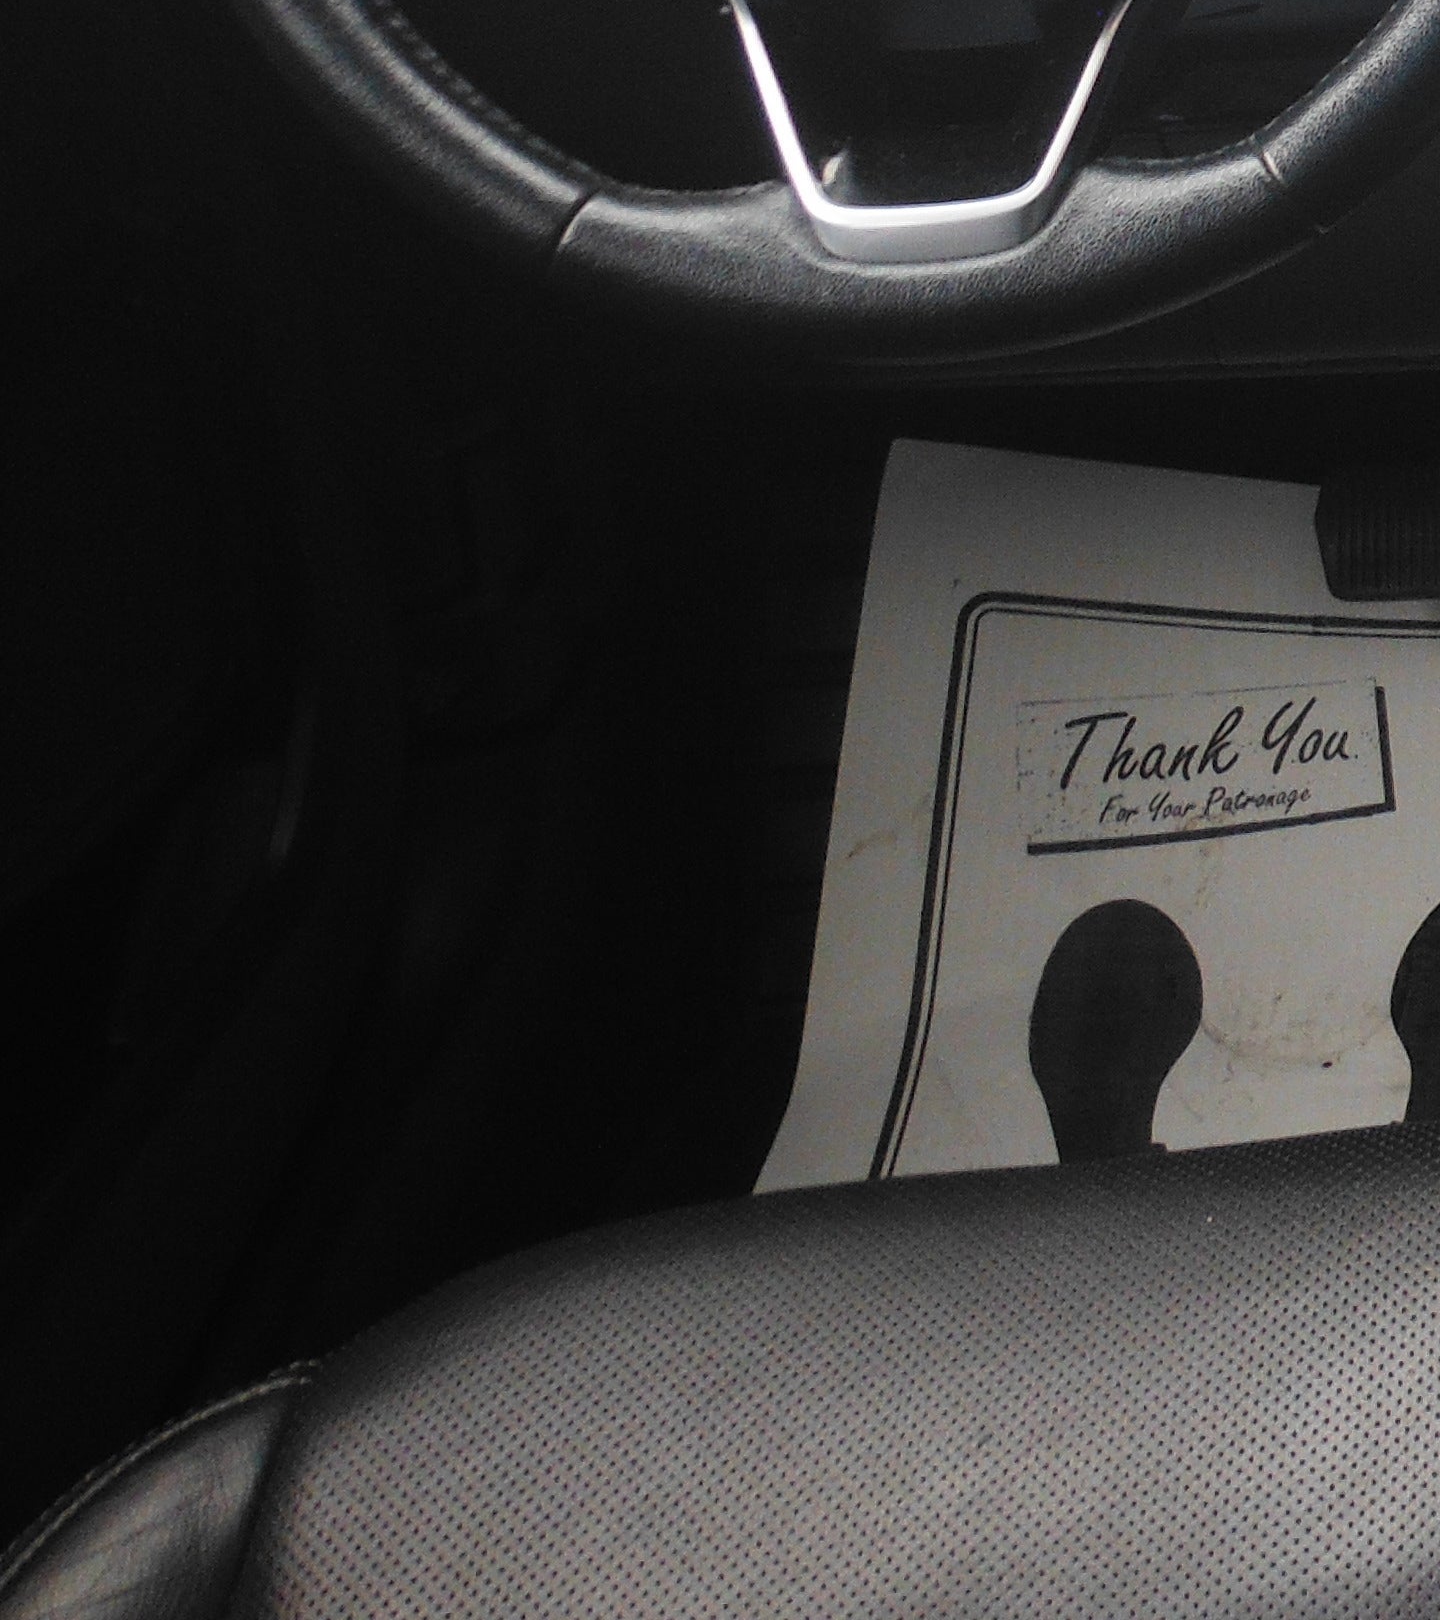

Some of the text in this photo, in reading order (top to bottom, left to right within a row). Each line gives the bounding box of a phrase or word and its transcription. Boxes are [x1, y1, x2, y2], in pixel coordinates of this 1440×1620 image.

[1060, 696, 1350, 790] Thank You
[1099, 785, 1312, 824] For Your Patronage
